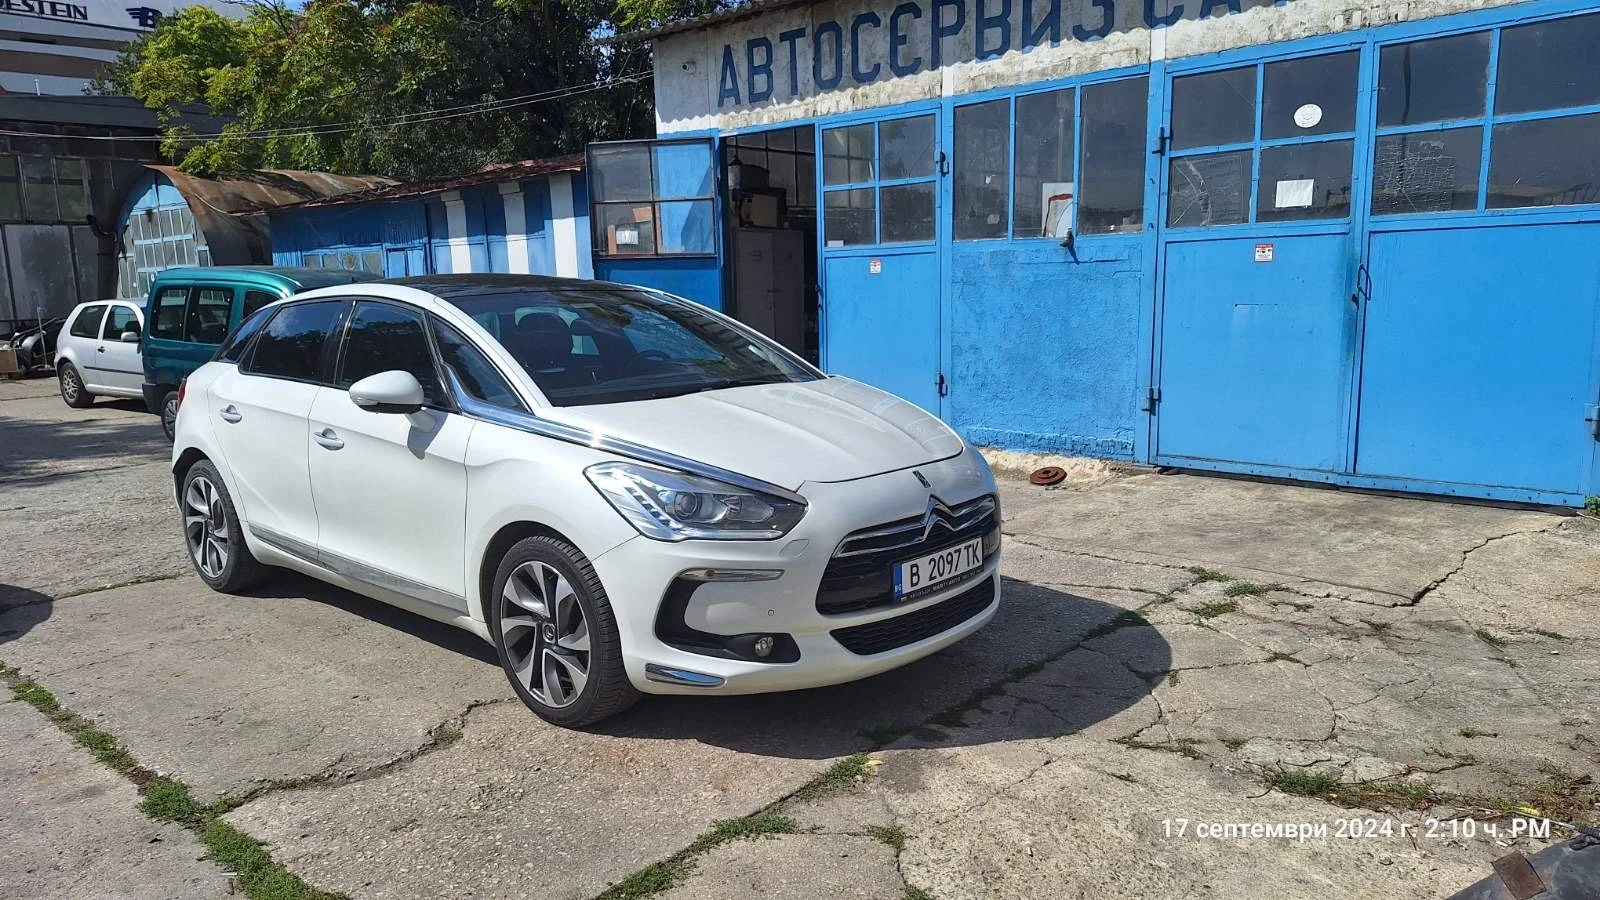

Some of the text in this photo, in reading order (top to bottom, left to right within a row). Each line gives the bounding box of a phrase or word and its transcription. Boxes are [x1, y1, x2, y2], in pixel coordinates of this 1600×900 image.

[909, 541, 980, 588] B 2097 TK
